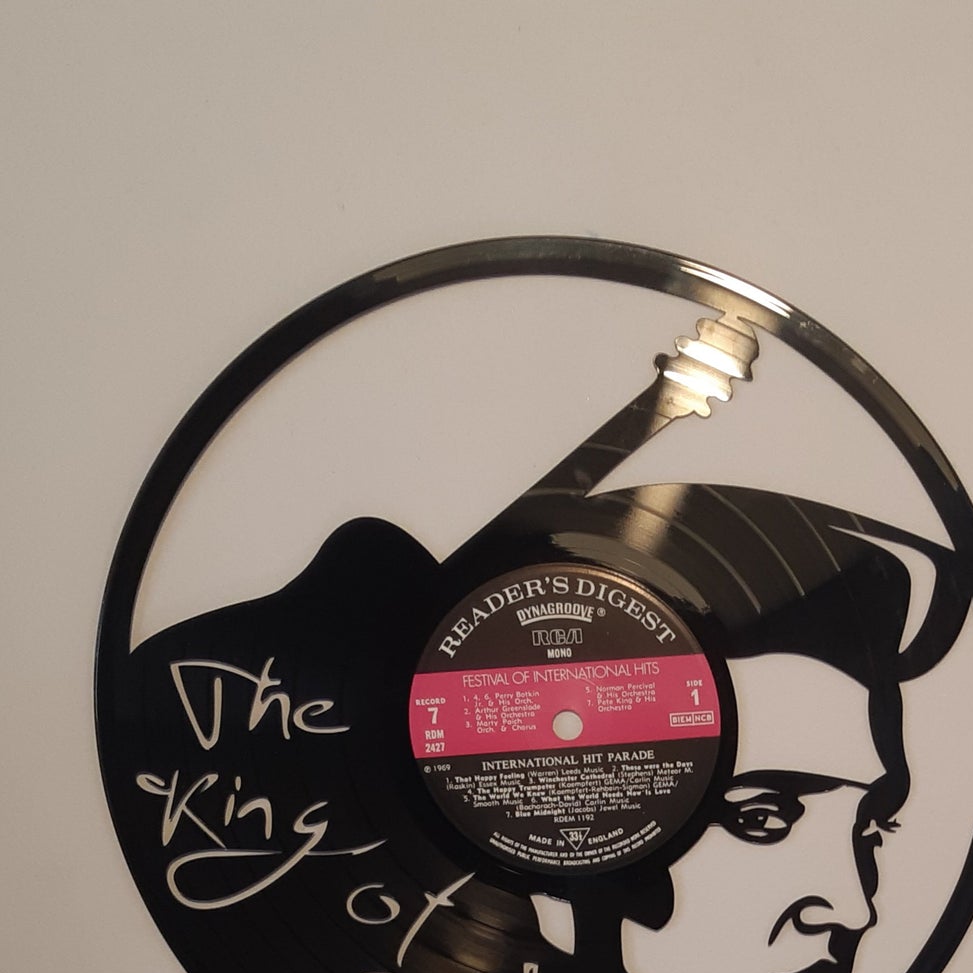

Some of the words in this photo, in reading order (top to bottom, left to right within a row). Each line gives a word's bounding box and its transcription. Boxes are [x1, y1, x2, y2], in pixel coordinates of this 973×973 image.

[516, 602, 595, 623] DYNAGROOVE
[575, 577, 677, 645] DIGEST
[531, 628, 583, 646] RCA
[547, 648, 573, 659] MONO
[462, 672, 509, 687] FESTIVAL
[512, 671, 530, 685] OF
[533, 664, 631, 683] INTERNATIONAL
[634, 662, 660, 675] HITS
[627, 682, 656, 690] Percival
[621, 690, 656, 698] Orchestra
[691, 688, 700, 706] 1
[170, 656, 351, 751] The
[415, 697, 446, 706] RECORD
[597, 698, 613, 706] Pete
[616, 697, 633, 706] King
[475, 706, 498, 714] Arthur
[598, 704, 632, 712] Orchestra
[427, 707, 438, 725] 7
[501, 711, 535, 719] Orchestra
[476, 719, 498, 727] Marty
[425, 729, 444, 740] RDM
[425, 742, 445, 753] 2427
[482, 755, 579, 771] INTERNATIONAL
[582, 753, 603, 765] HIT
[607, 750, 655, 762] PARADE
[433, 764, 451, 772] 1969
[474, 775, 497, 783] Happy
[499, 772, 525, 781] Feeling
[527, 769, 559, 778] (Warren)
[561, 767, 581, 775] Leeds
[583, 766, 604, 774] Music
[662, 761, 674, 769] the
[479, 781, 497, 789] Essex
[500, 779, 521, 787] Music
[539, 775, 578, 783] Winchester
[580, 772, 615, 781] Cathedral
[657, 768, 681, 776] Meteor
[492, 786, 516, 795] Happy
[518, 783, 556, 793] Trumpeter
[473, 801, 500, 809] Smooth
[541, 795, 563, 803] What
[563, 794, 576, 802] the
[578, 792, 599, 800] World
[602, 791, 623, 799] Needs
[626, 789, 642, 797] Now
[489, 793, 510, 801] World
[526, 790, 546, 798] Knew
[585, 798, 607, 807] Carlin
[609, 797, 630, 805] Music
[533, 808, 566, 817] Midnight
[567, 805, 597, 814] (Jacobs)
[600, 804, 618, 812] Jewel
[553, 815, 576, 823] RDEM
[577, 814, 595, 822] 1192
[136, 769, 389, 910] King
[528, 834, 553, 846] MADE
[587, 827, 624, 845] ENGLAND
[345, 871, 476, 967] of
